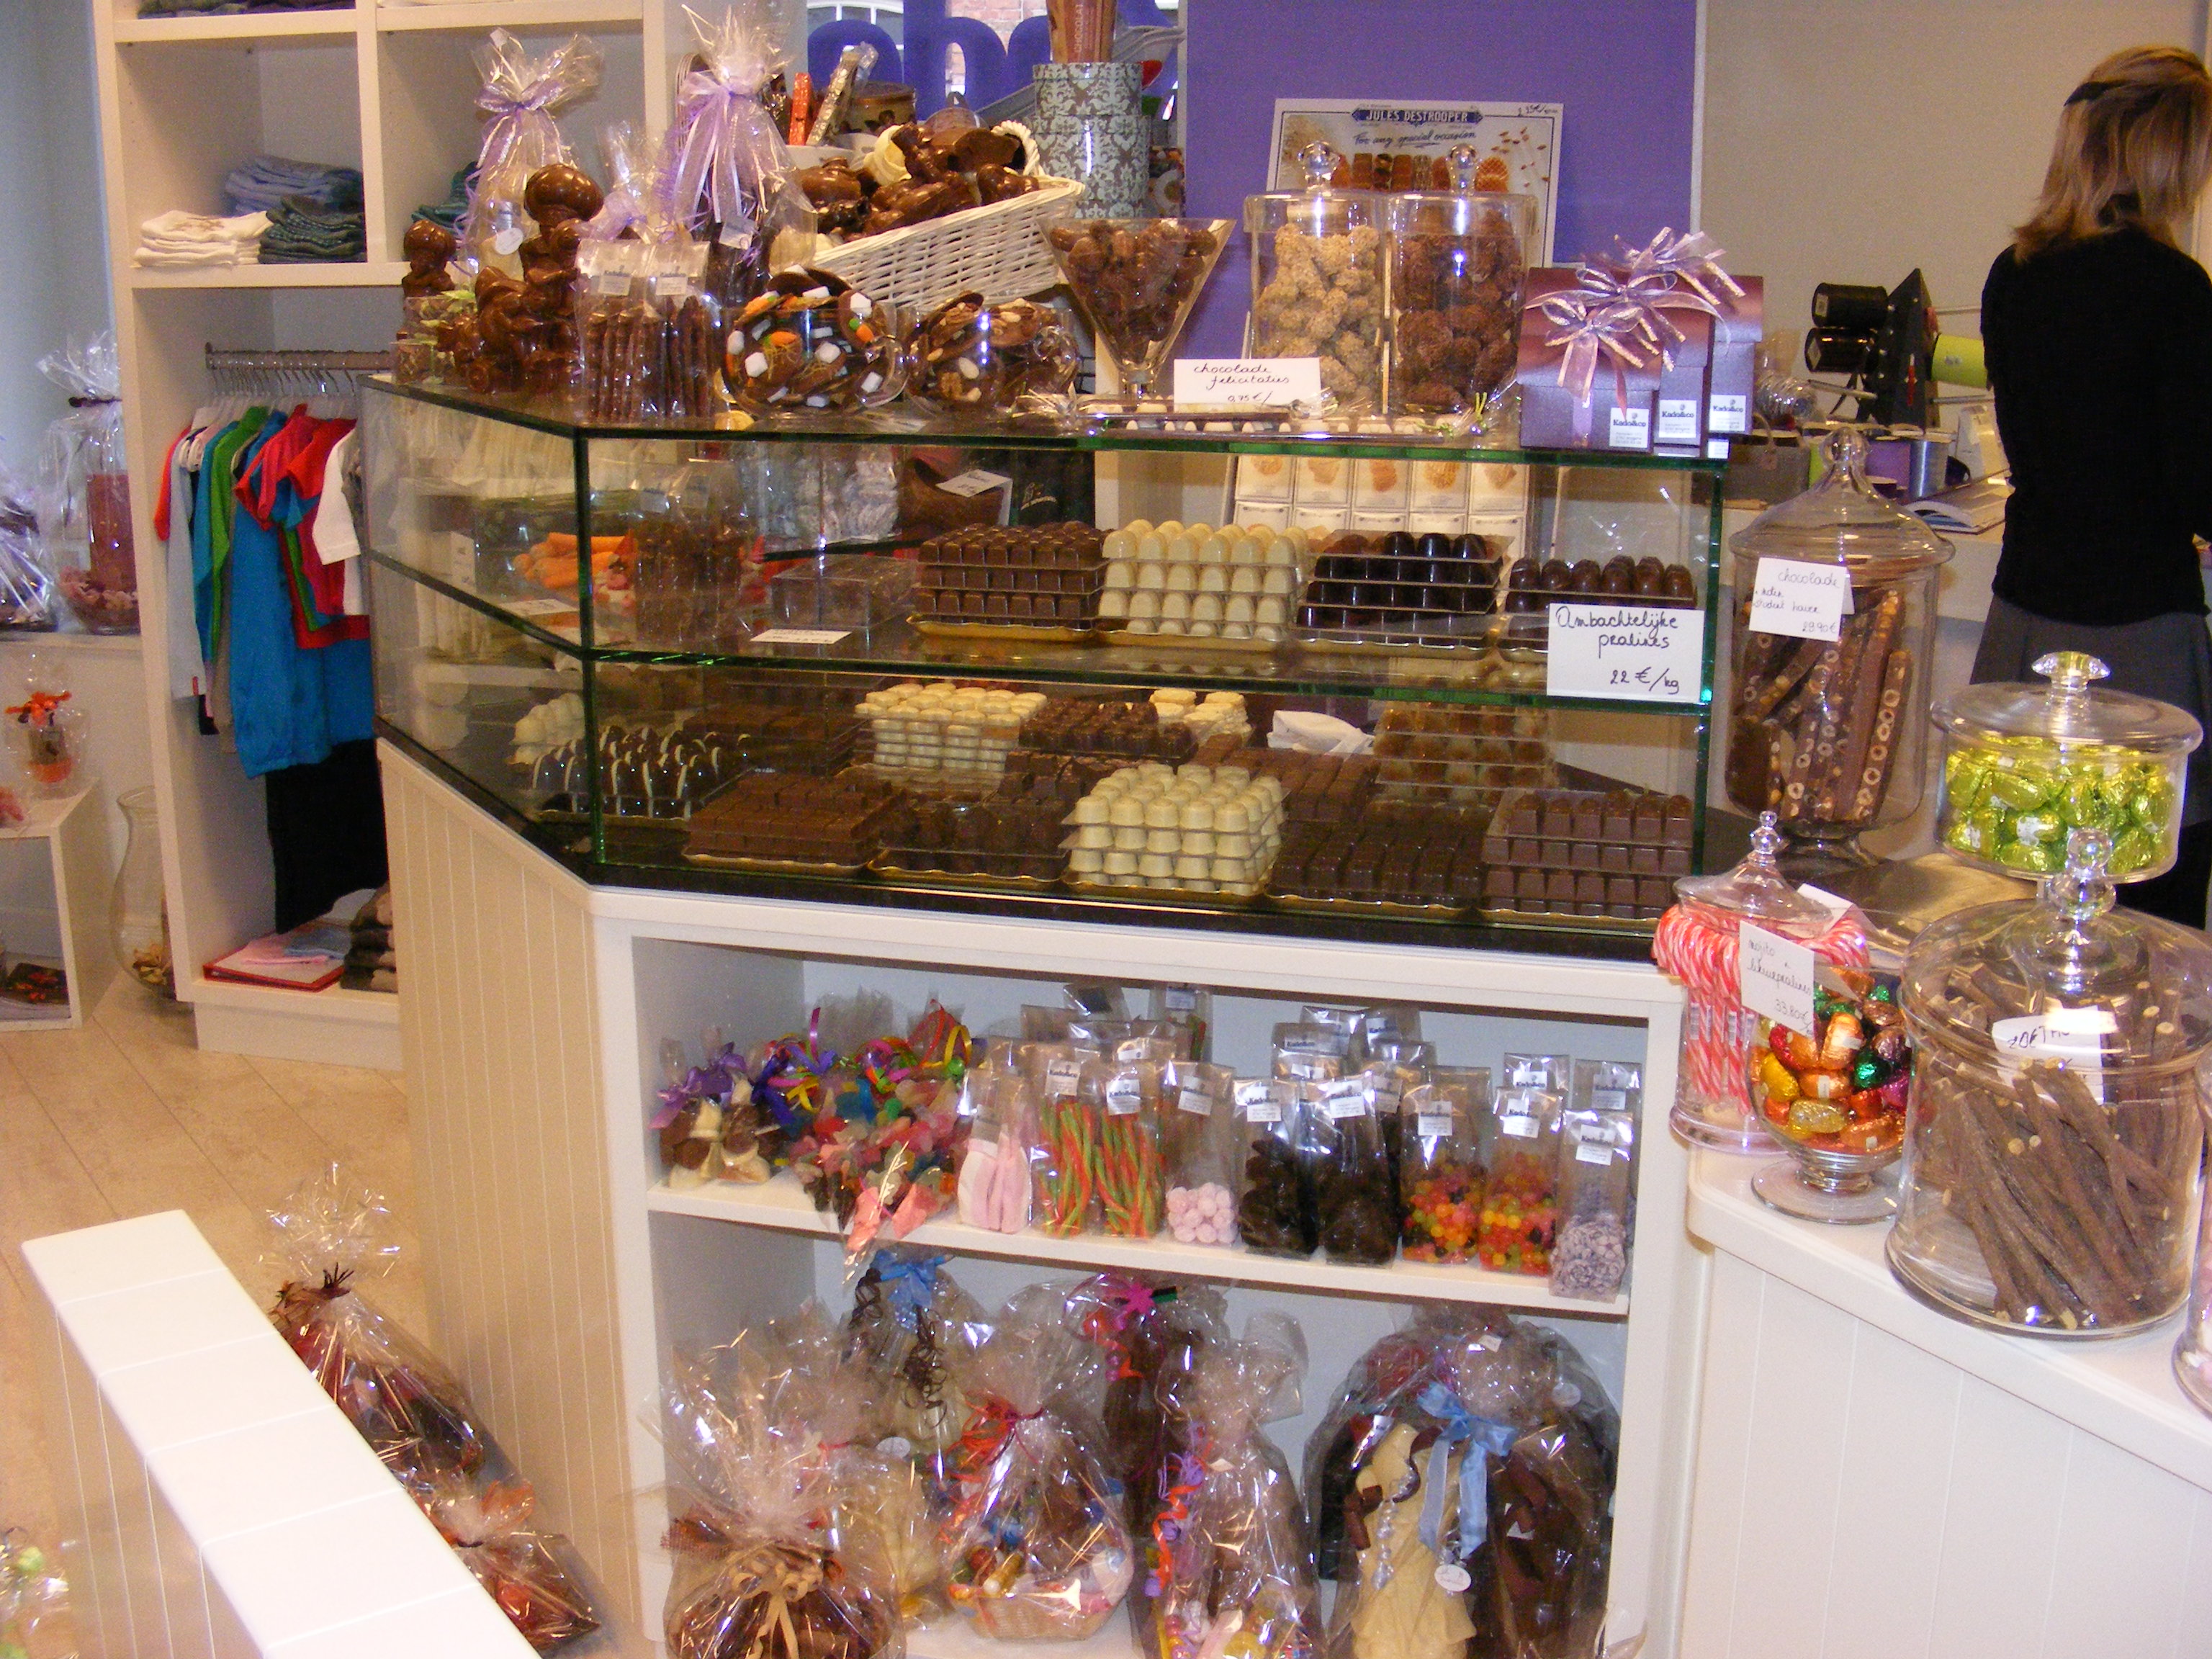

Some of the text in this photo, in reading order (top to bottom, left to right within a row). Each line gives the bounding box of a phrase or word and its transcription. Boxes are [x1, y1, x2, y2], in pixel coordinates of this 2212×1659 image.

[1365, 109, 1469, 123] JULES DESTROOPER
[1353, 132, 1369, 145] For
[1372, 136, 1393, 148] any
[1398, 130, 1434, 148] special
[1194, 363, 1272, 373] chocolade
[1778, 568, 1840, 588] chocolade
[1555, 606, 1678, 639] Ambachtelijke
[1599, 631, 1670, 659] pralines
